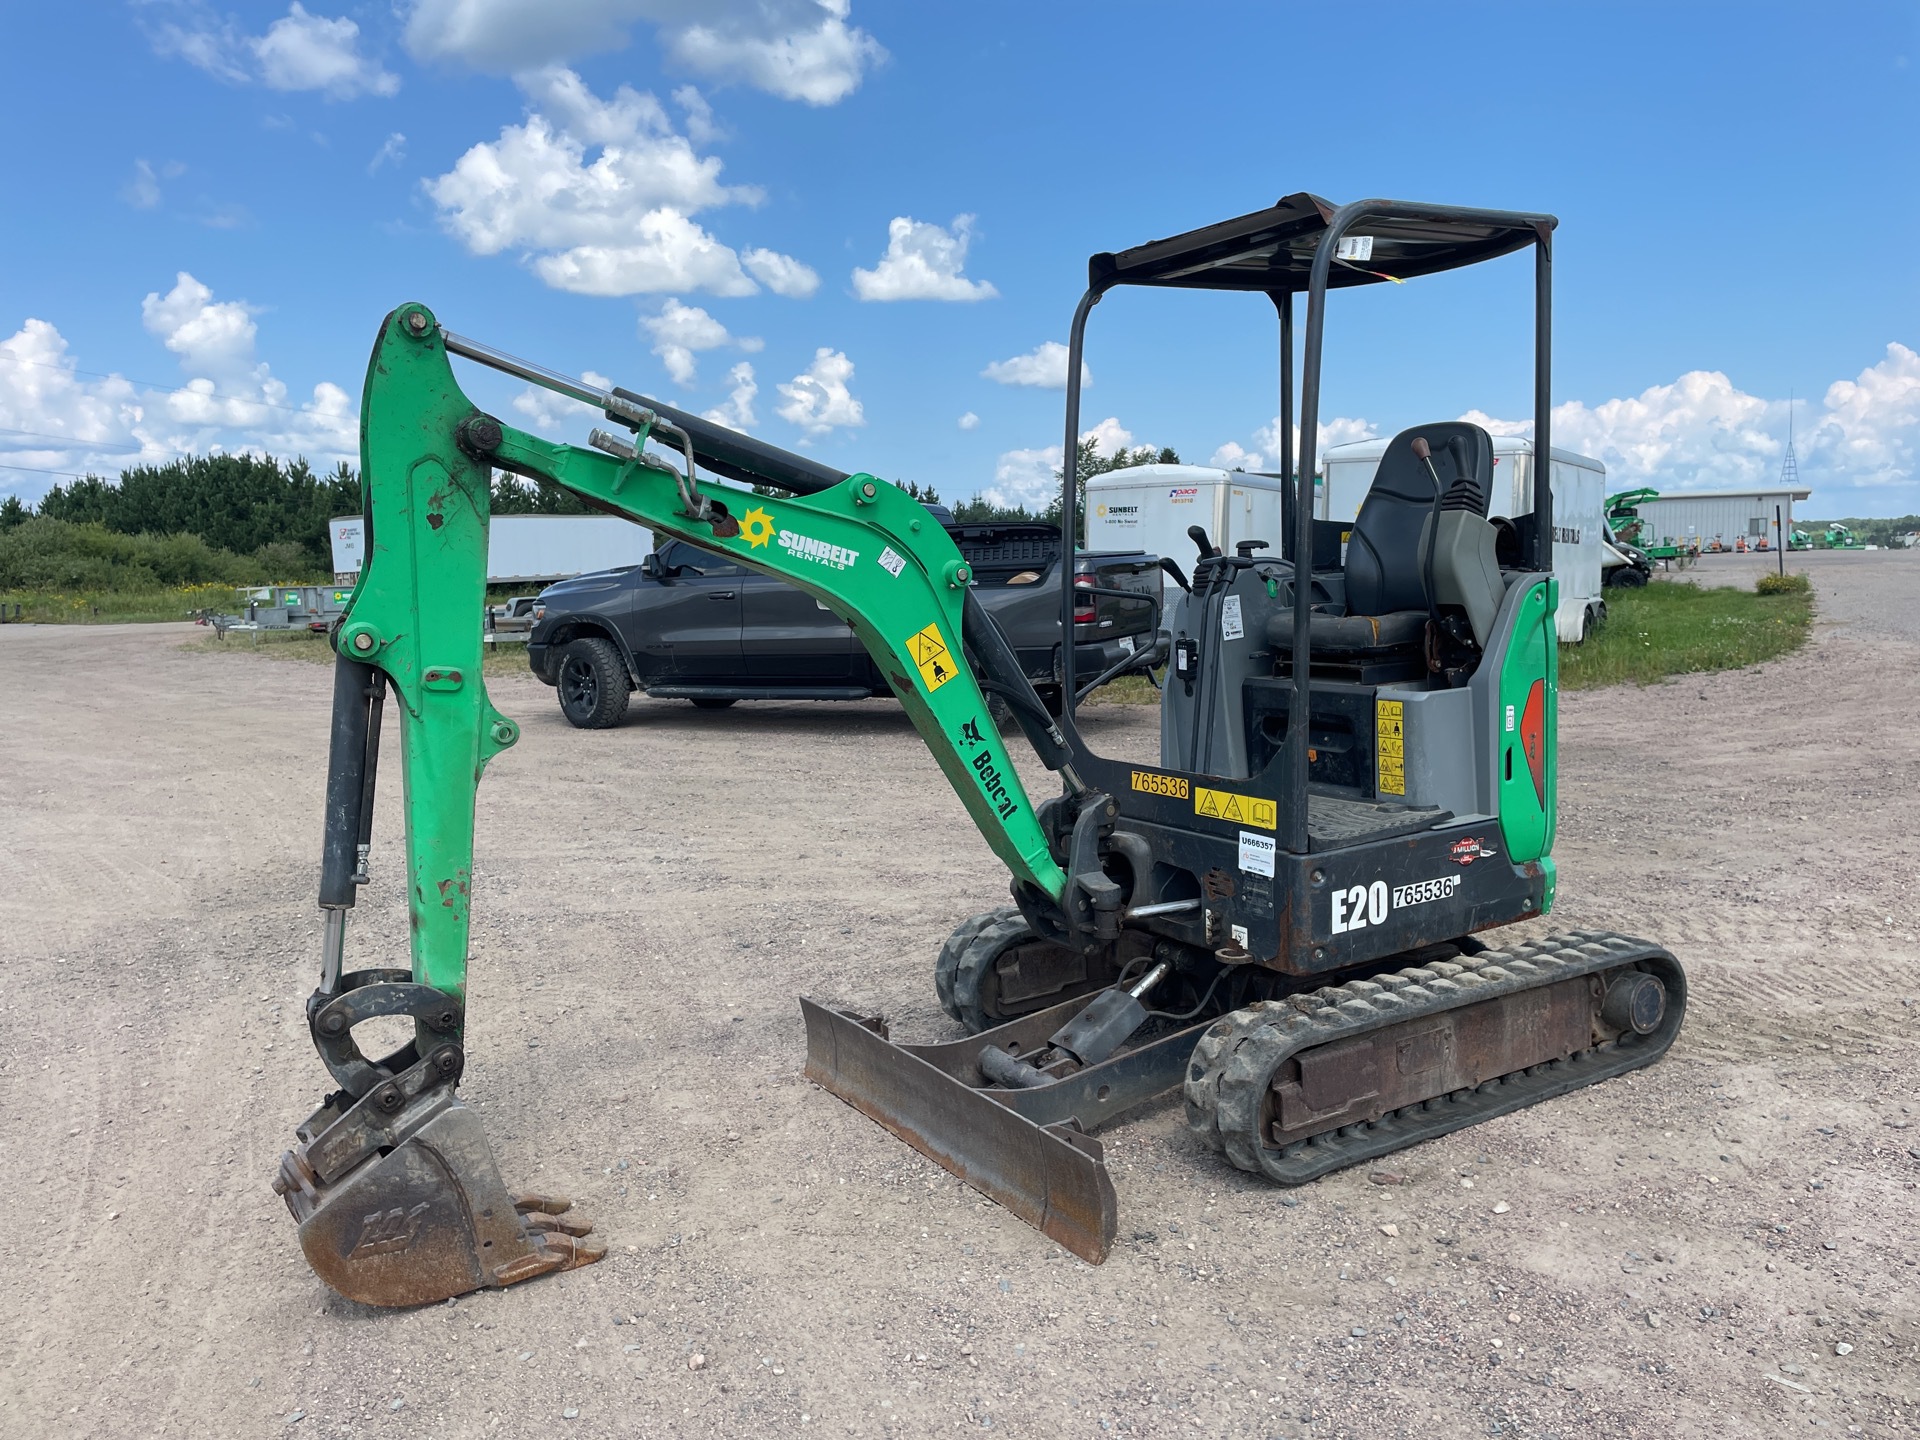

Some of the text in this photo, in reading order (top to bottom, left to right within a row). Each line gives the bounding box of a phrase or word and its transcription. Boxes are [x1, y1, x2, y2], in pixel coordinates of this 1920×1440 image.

[1175, 488, 1198, 497] pace
[1108, 506, 1139, 514] SUNBELT
[778, 530, 860, 567] SUNBELT
[787, 548, 845, 571] RENTALS
[972, 750, 1018, 821] Bobcat
[1133, 772, 1188, 798] 765536
[1242, 836, 1273, 850] U666357
[1457, 843, 1480, 853] MILLION
[1394, 878, 1453, 907] 765536
[1332, 880, 1388, 935] E20
